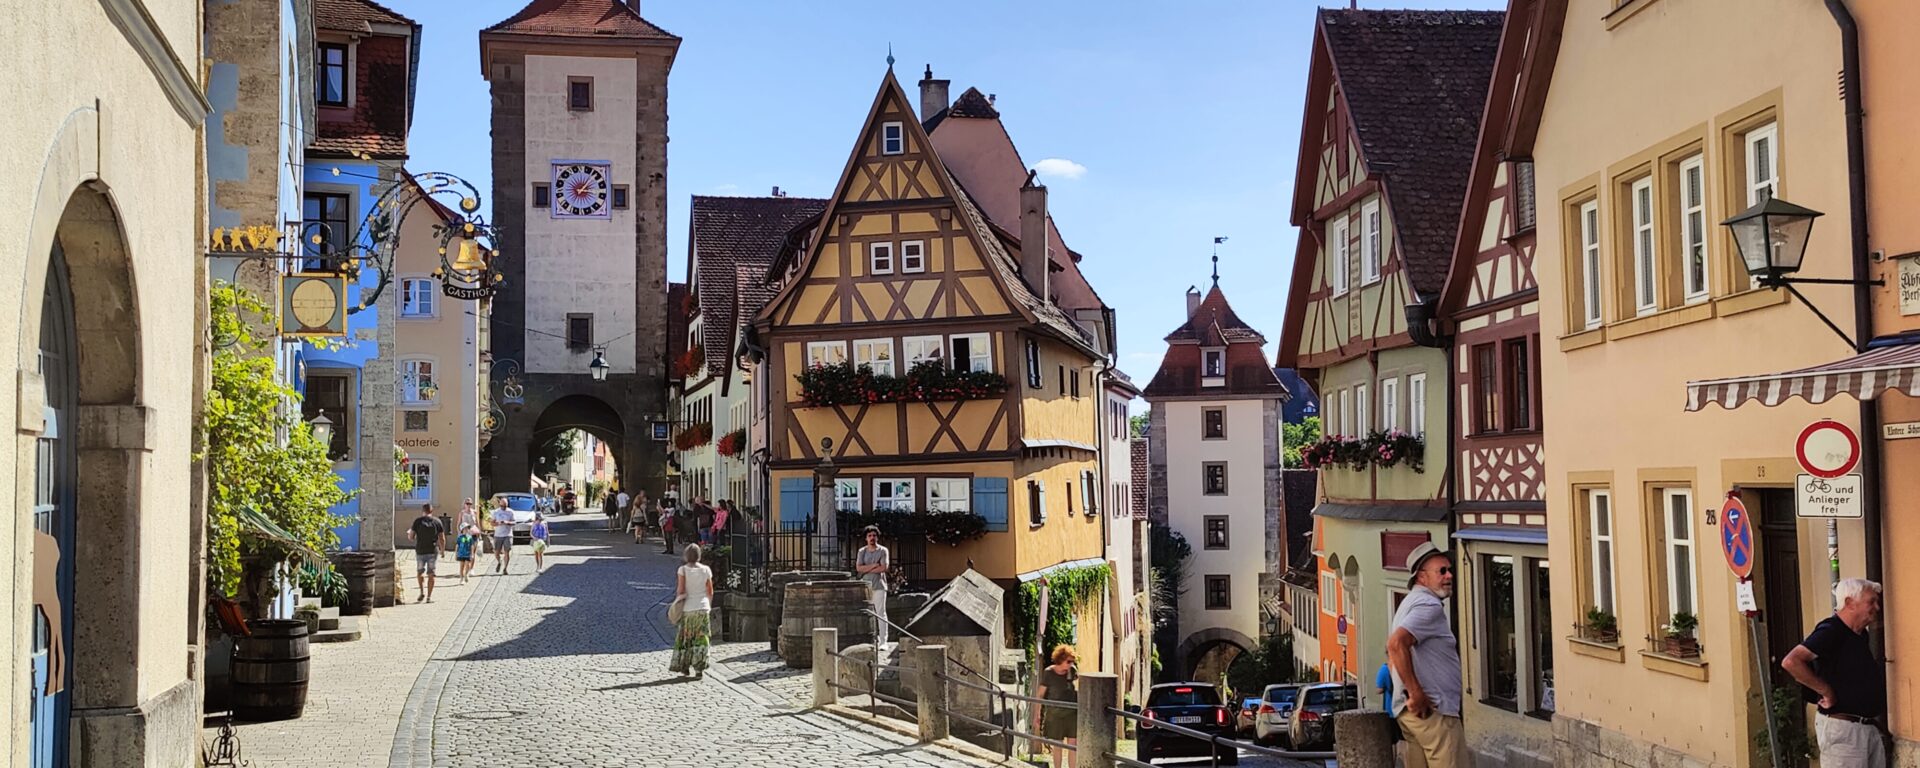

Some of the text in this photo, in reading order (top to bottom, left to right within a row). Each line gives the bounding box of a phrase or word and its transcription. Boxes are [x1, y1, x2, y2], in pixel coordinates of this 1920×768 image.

[447, 286, 490, 298] GASTHOF
[395, 437, 440, 447] olaterie
[1835, 486, 1854, 494] und
[1808, 495, 1851, 505] Anlieger
[1821, 505, 1839, 513] frei
